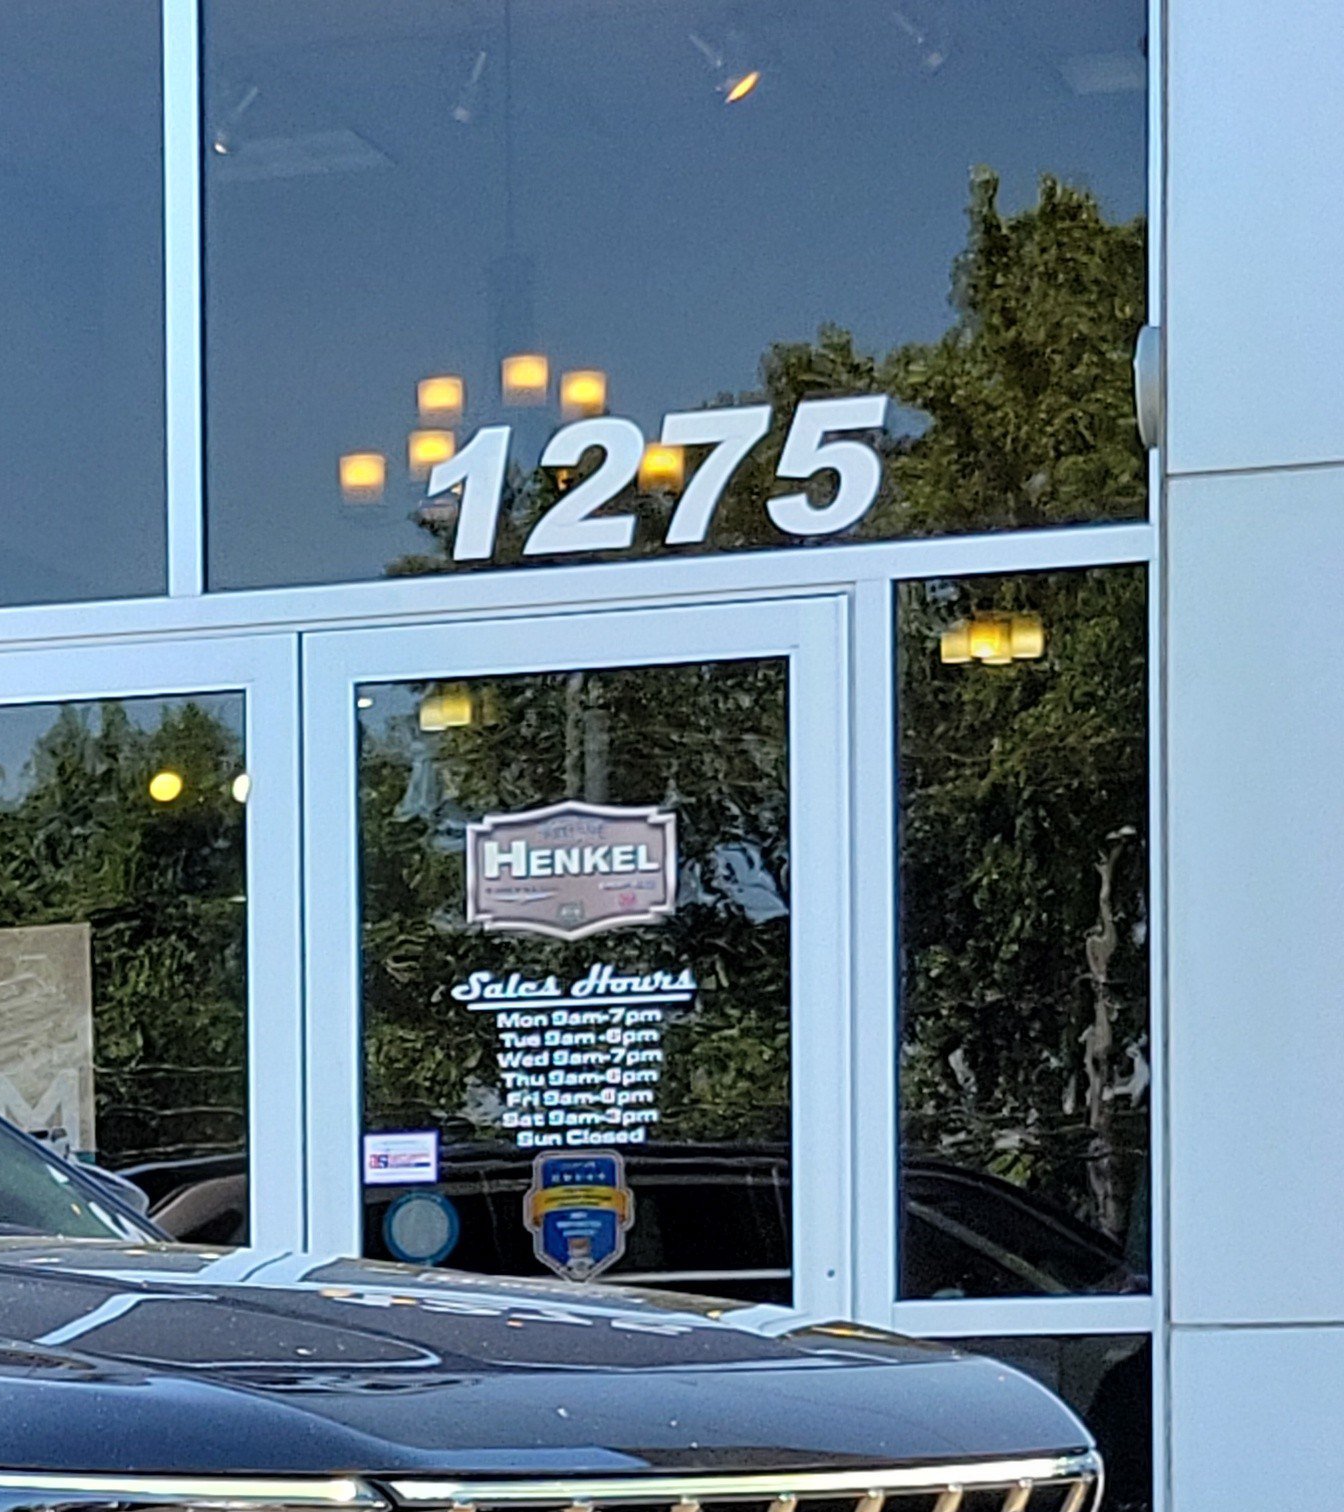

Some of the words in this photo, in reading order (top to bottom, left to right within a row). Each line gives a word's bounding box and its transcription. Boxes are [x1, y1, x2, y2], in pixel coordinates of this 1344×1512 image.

[426, 395, 889, 562] 1275
[484, 841, 661, 878] HENKEL
[451, 970, 561, 1000] Sales
[570, 963, 697, 997] Hours
[496, 1012, 548, 1029] Mon
[551, 1008, 662, 1026] 9am-7pm
[499, 1031, 542, 1048] Tue
[496, 1052, 549, 1068] Wed
[552, 1048, 663, 1067] 9am-7pm
[501, 1072, 546, 1088] Thu
[506, 1091, 541, 1108] Fri
[502, 1111, 546, 1128] Sat
[516, 1131, 562, 1147] Sun
[565, 1127, 647, 1145] Closed
